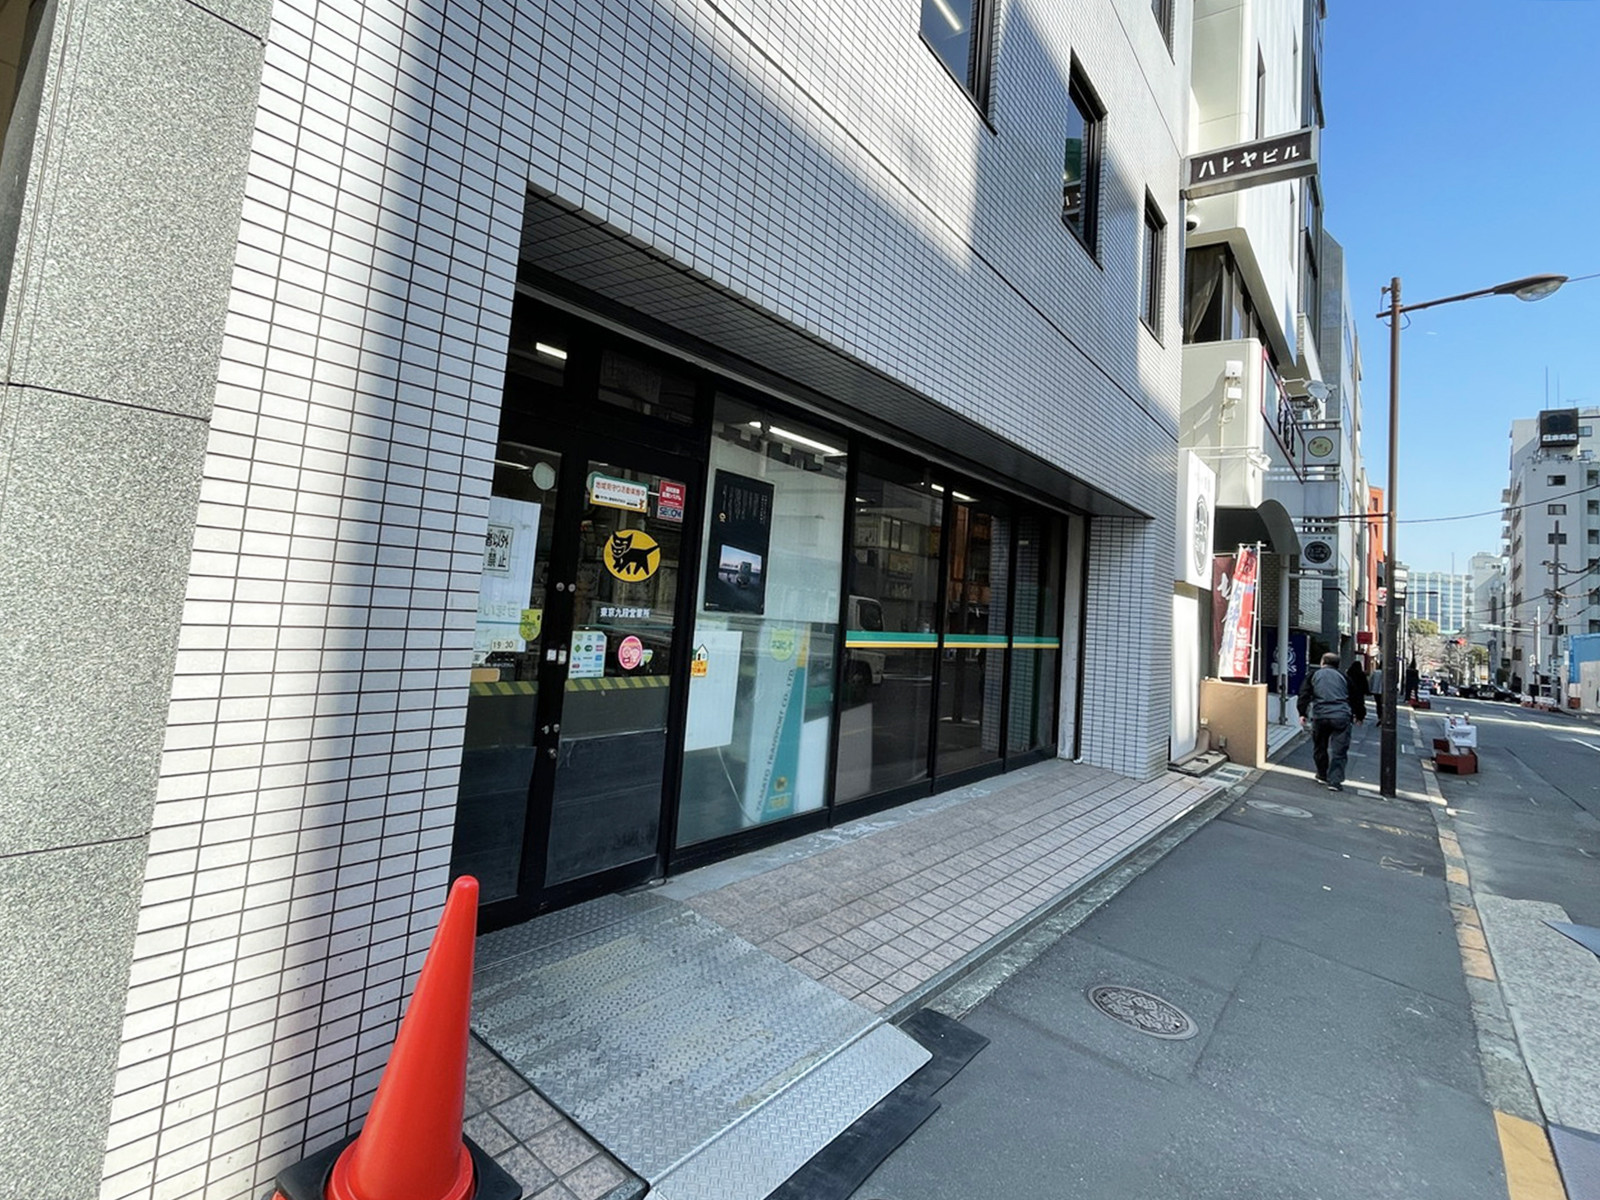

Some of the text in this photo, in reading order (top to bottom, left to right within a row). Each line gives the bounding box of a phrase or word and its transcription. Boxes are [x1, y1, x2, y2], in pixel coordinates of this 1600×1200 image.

[1198, 145, 1300, 178] ハトヤビル
